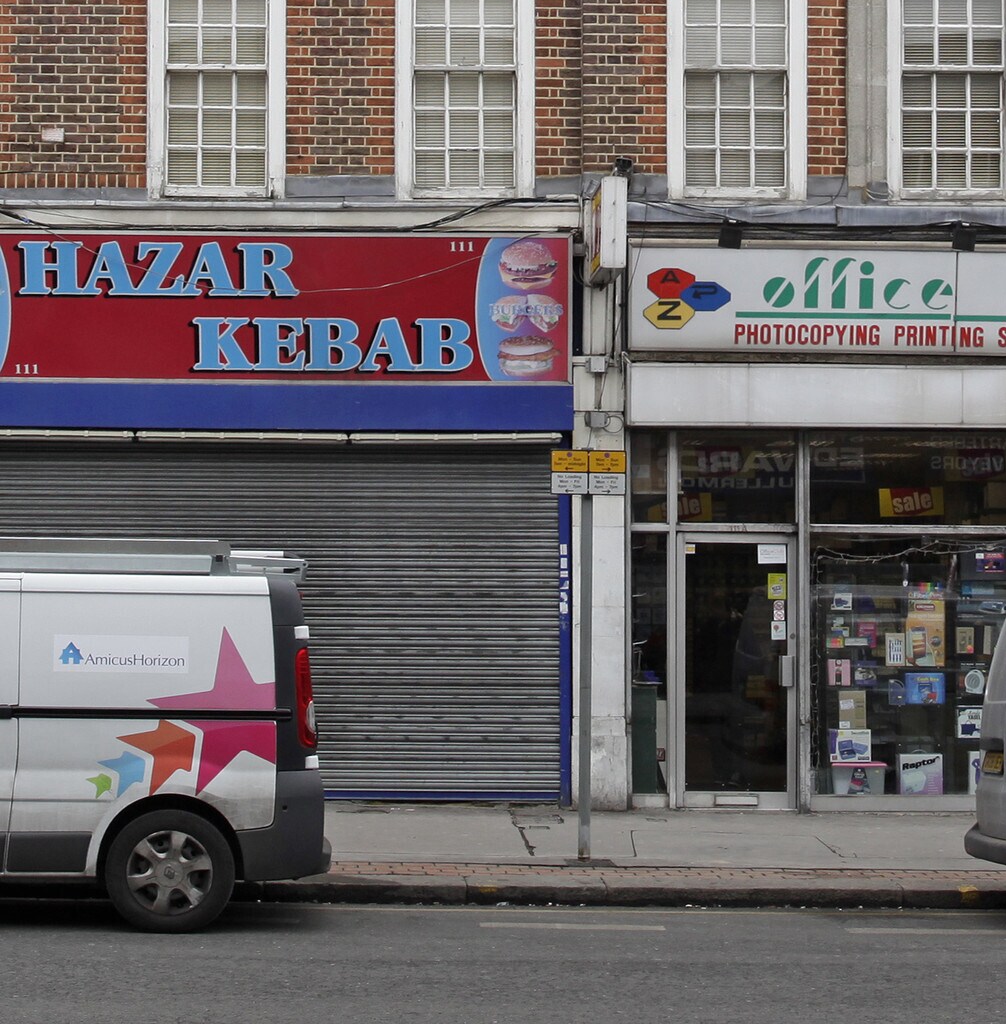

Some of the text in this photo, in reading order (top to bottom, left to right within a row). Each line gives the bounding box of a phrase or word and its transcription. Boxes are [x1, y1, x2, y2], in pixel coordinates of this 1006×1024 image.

[450, 241, 474, 252] 111
[17, 240, 300, 297] HAZAR
[660, 270, 681, 284] A
[763, 257, 953, 310] office
[489, 303, 564, 316] BURGERS
[734, 323, 881, 346] PHOTOCOPYING
[894, 325, 985, 348] PRINTING
[192, 317, 474, 372] KEBAB
[15, 363, 39, 375] 111
[892, 491, 933, 513] sale
[84, 653, 185, 667] AmicusHorizon
[902, 755, 941, 771] Raptor
